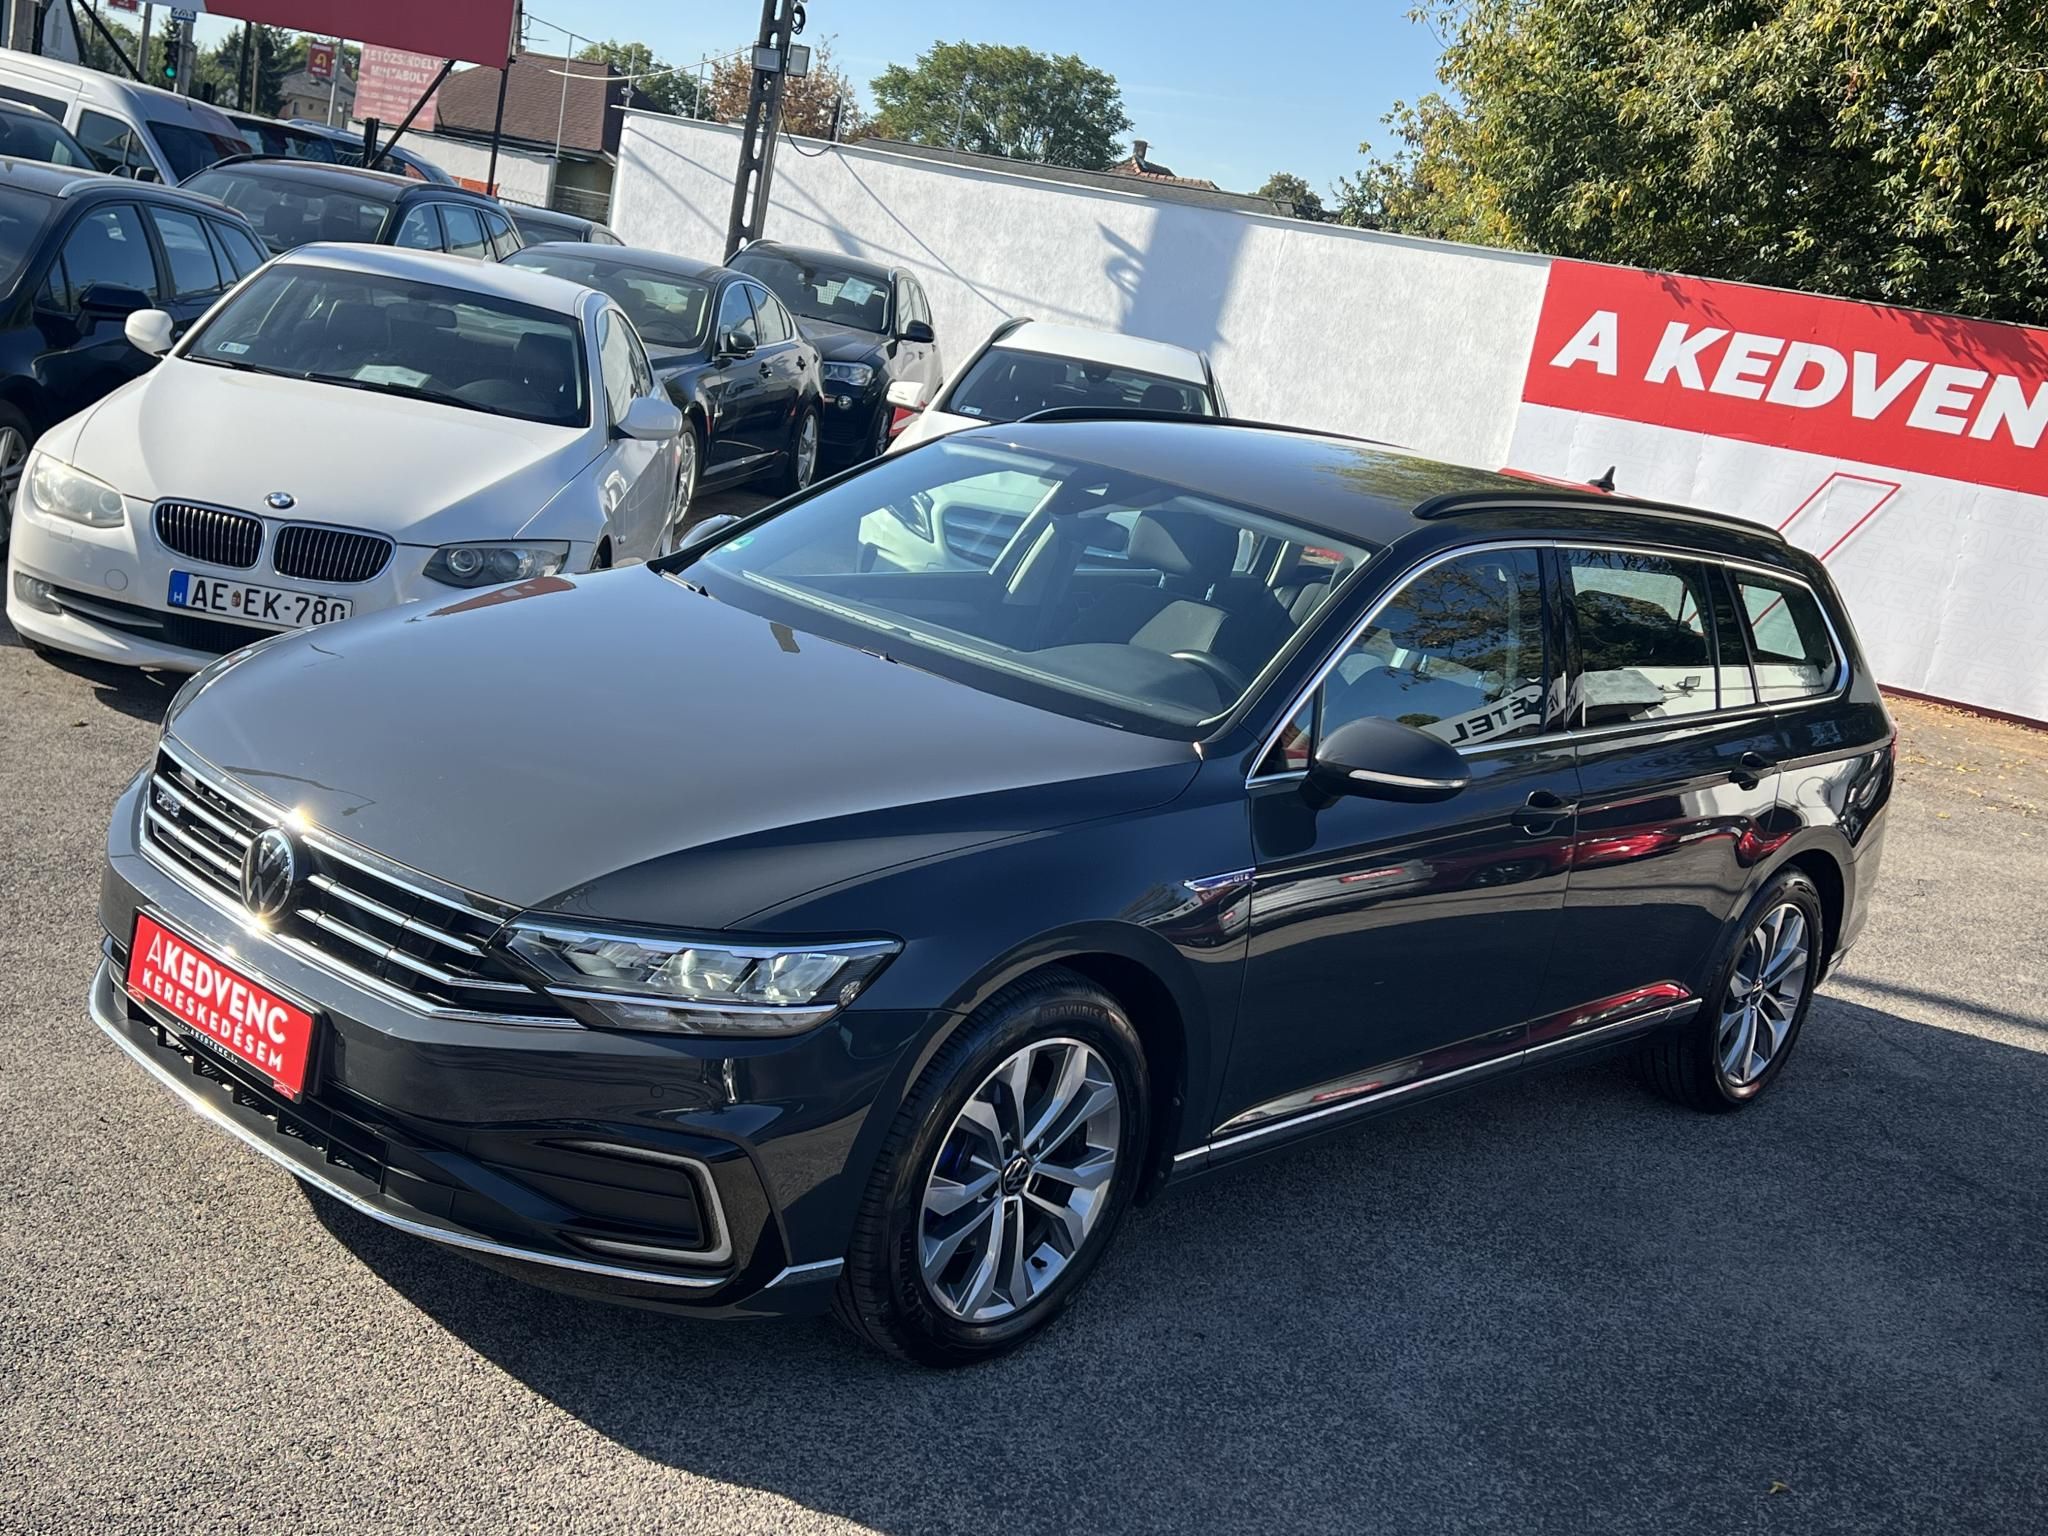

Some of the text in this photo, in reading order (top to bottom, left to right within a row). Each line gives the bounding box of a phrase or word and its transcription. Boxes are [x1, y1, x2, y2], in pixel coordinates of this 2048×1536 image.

[1549, 309, 2048, 449] A KEDVEN
[173, 591, 183, 603] H
[191, 580, 229, 611] AE
[142, 967, 284, 1072] KERESKEDÉSEM
